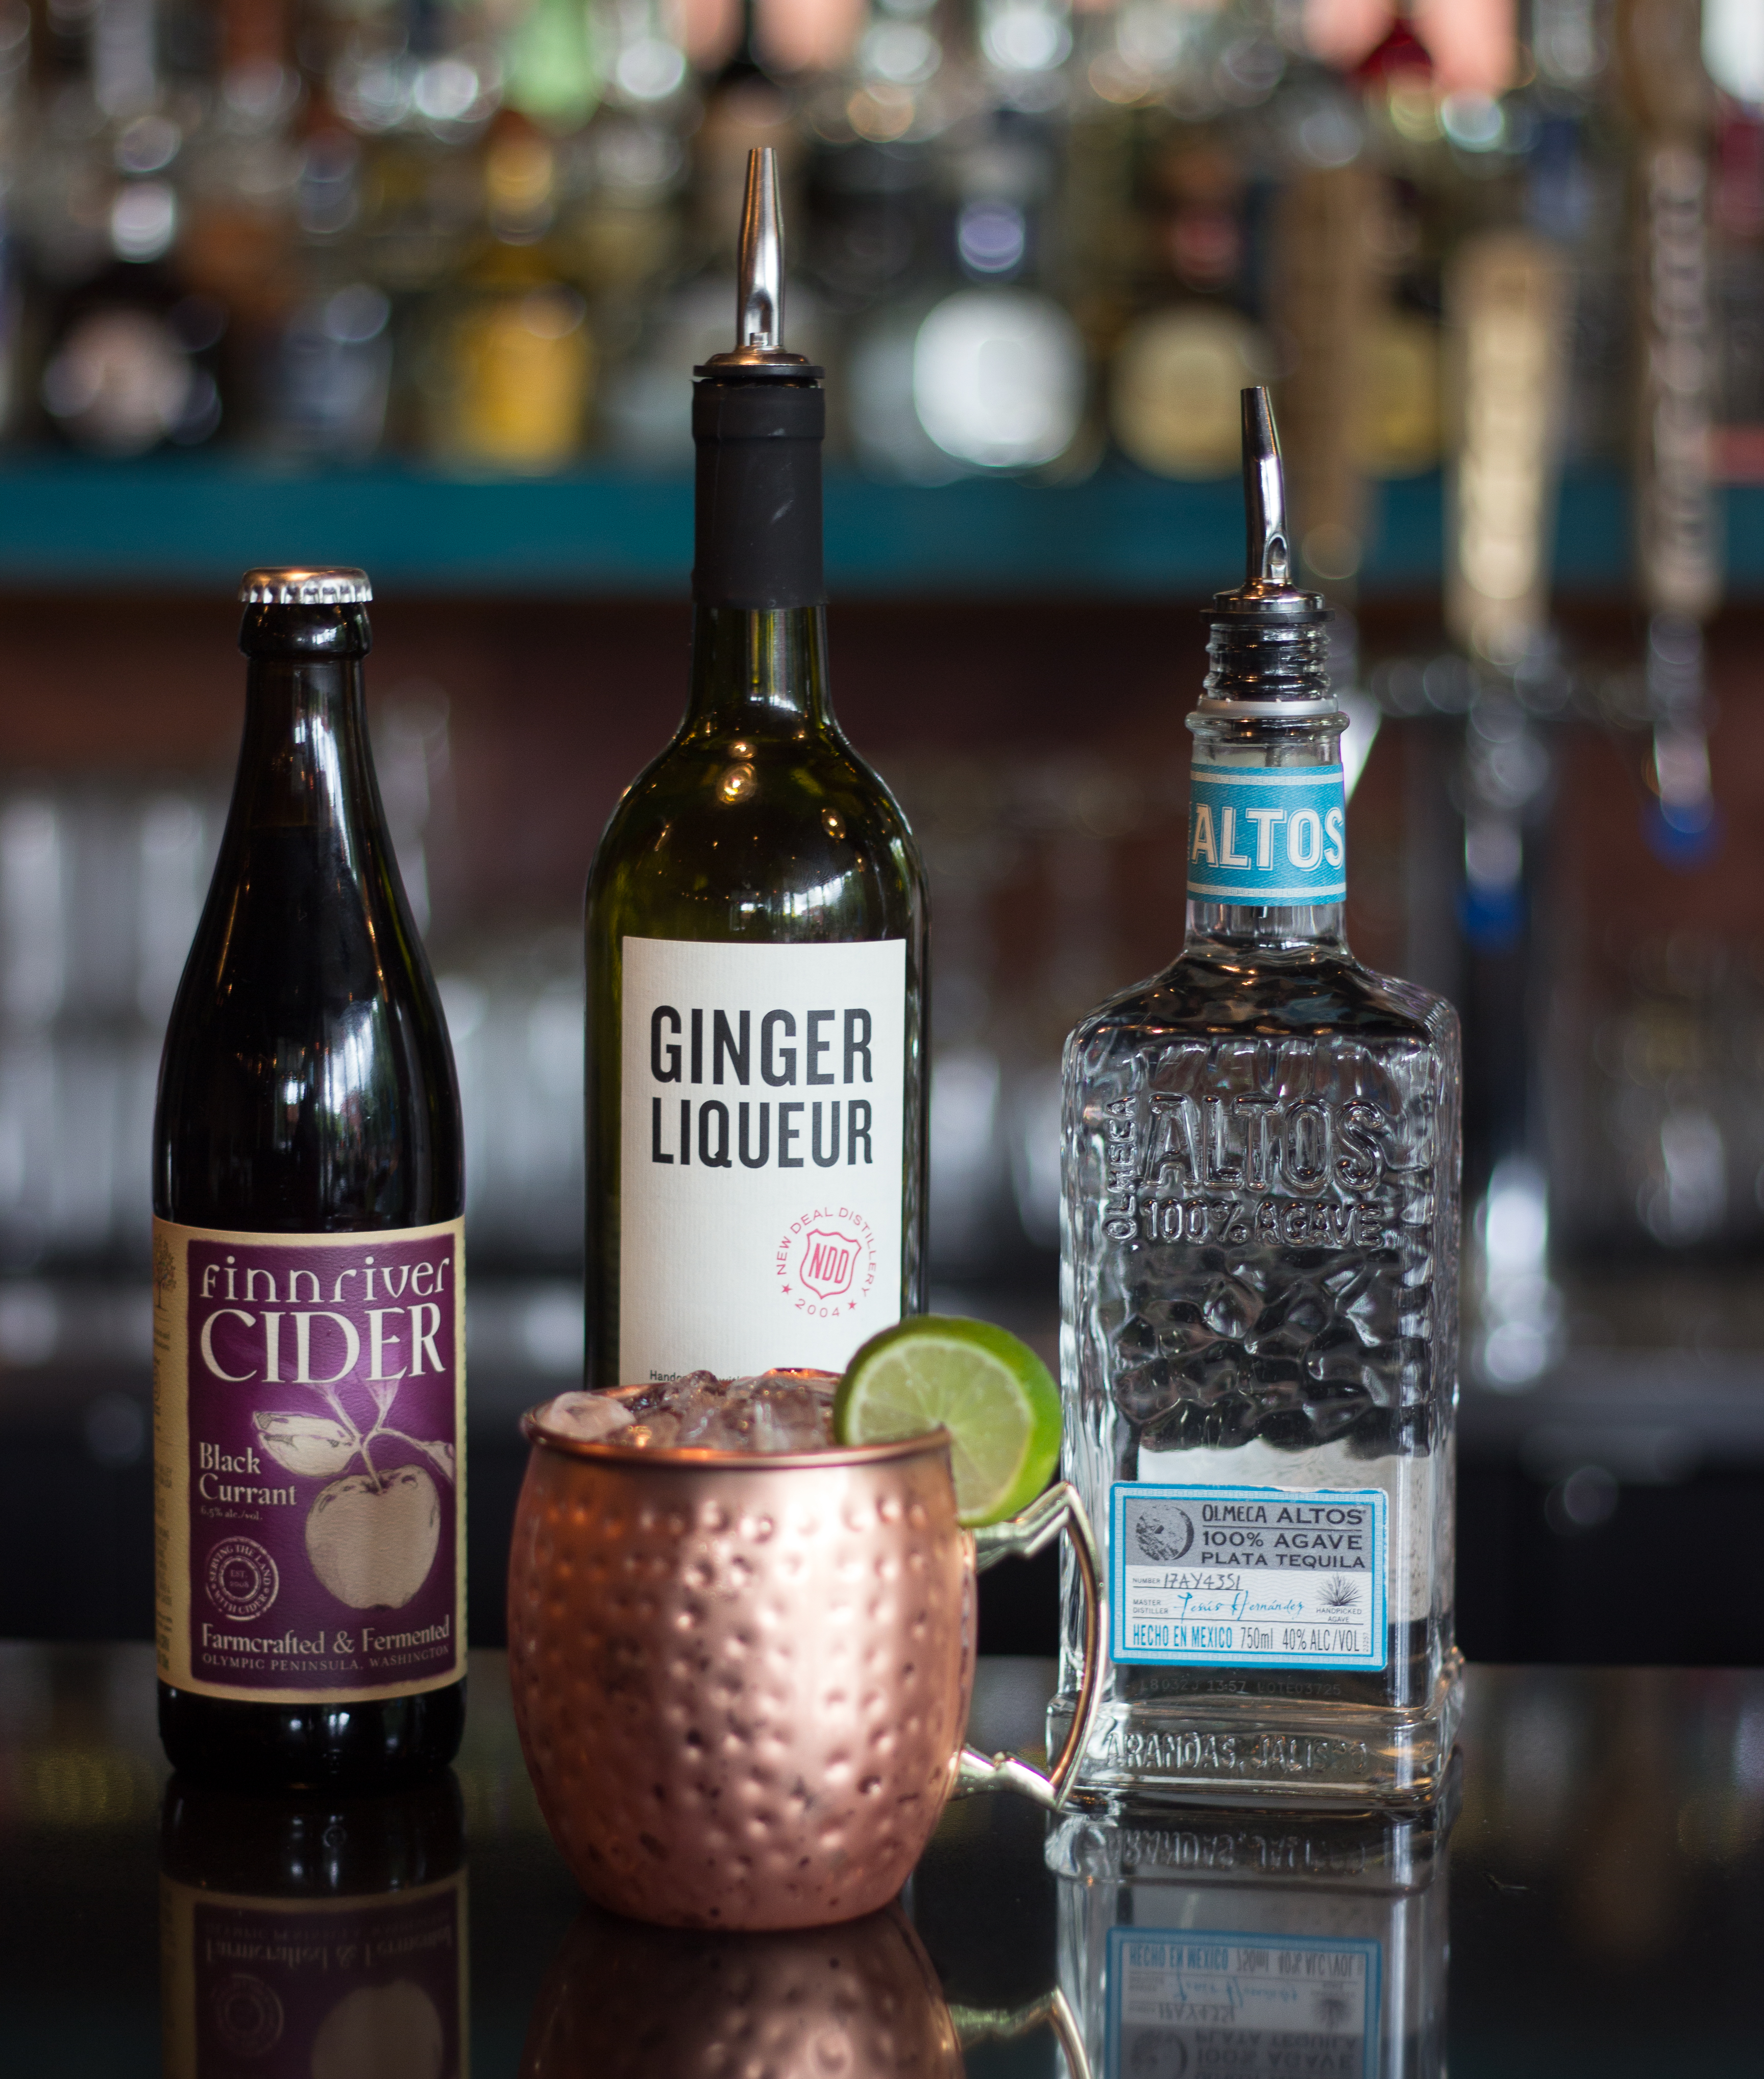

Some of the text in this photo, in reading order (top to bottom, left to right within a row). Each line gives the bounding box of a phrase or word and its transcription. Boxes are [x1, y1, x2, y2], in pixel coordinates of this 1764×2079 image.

[1191, 803, 1344, 872] ALTOS
[651, 1005, 873, 1086] GINGER
[652, 1097, 873, 1169] LIQUEUR
[1140, 1092, 1387, 1192] ALTOS
[1102, 1096, 1138, 1242] OLMECA
[1141, 1198, 1384, 1247] 100% AGAVE
[776, 1206, 877, 1297] NEW DEAL DISTILLERY
[808, 1243, 850, 1284] NDD
[200, 1256, 449, 1302] finnriver
[794, 1298, 840, 1318] 2004
[201, 1303, 446, 1384] CIDER
[199, 1442, 261, 1474] Black
[200, 1473, 297, 1506] Currant
[1202, 1504, 1267, 1524] OLMECA
[1201, 1551, 1365, 1569] PLATA TEQUILA
[1203, 1531, 1362, 1551] 100% AGAVE
[209, 1544, 272, 1585] SERVING THE LAND
[1132, 1577, 1160, 1585] NUMBER
[214, 1590, 267, 1614] WITH CIDER
[1133, 1607, 1168, 1615] DISTILLER
[202, 1614, 450, 1655] Farmcrafted & Fermented
[1133, 1624, 1168, 1647] HECHO
[1174, 1626, 1187, 1647] EN
[1191, 1626, 1233, 1649] MEXICO
[1240, 1627, 1273, 1650] 750ml
[1282, 1628, 1307, 1650] 40%
[203, 1652, 265, 1670] OLYMPIC
[370, 1645, 450, 1668] WASHINGTON
